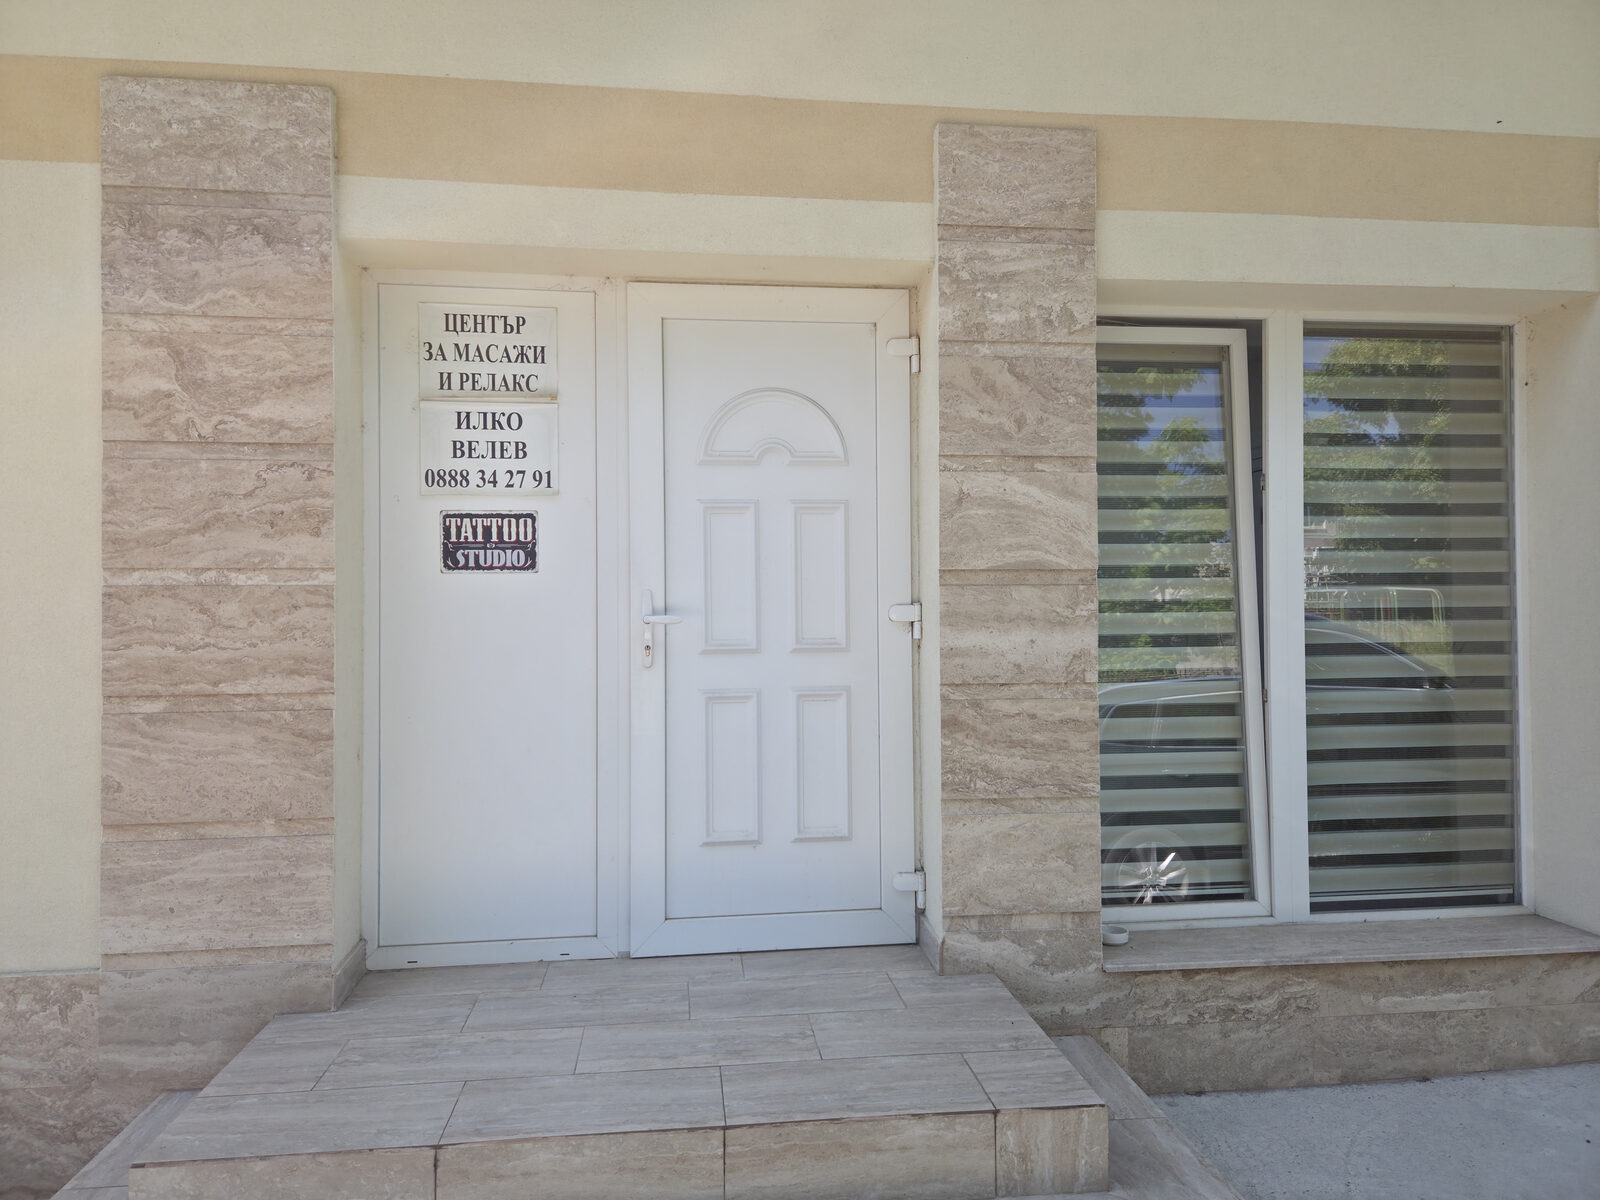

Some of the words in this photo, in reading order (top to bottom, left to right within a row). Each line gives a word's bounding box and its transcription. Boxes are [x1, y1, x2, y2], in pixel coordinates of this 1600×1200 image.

[444, 313, 526, 335] ЦЕНТЪР
[423, 341, 447, 362] ЗА
[452, 342, 546, 364] МАСАЖИ
[438, 371, 452, 391] И
[458, 372, 538, 392] РЕЛАКС
[455, 411, 523, 431] ИЛКО
[451, 440, 528, 460] ВЕЛЕВ
[424, 468, 470, 488] 0888
[476, 469, 498, 488] 34
[504, 469, 526, 488] 27
[532, 469, 553, 489] 91
[445, 517, 534, 543] TATTOO
[455, 549, 526, 568] STUDIO
